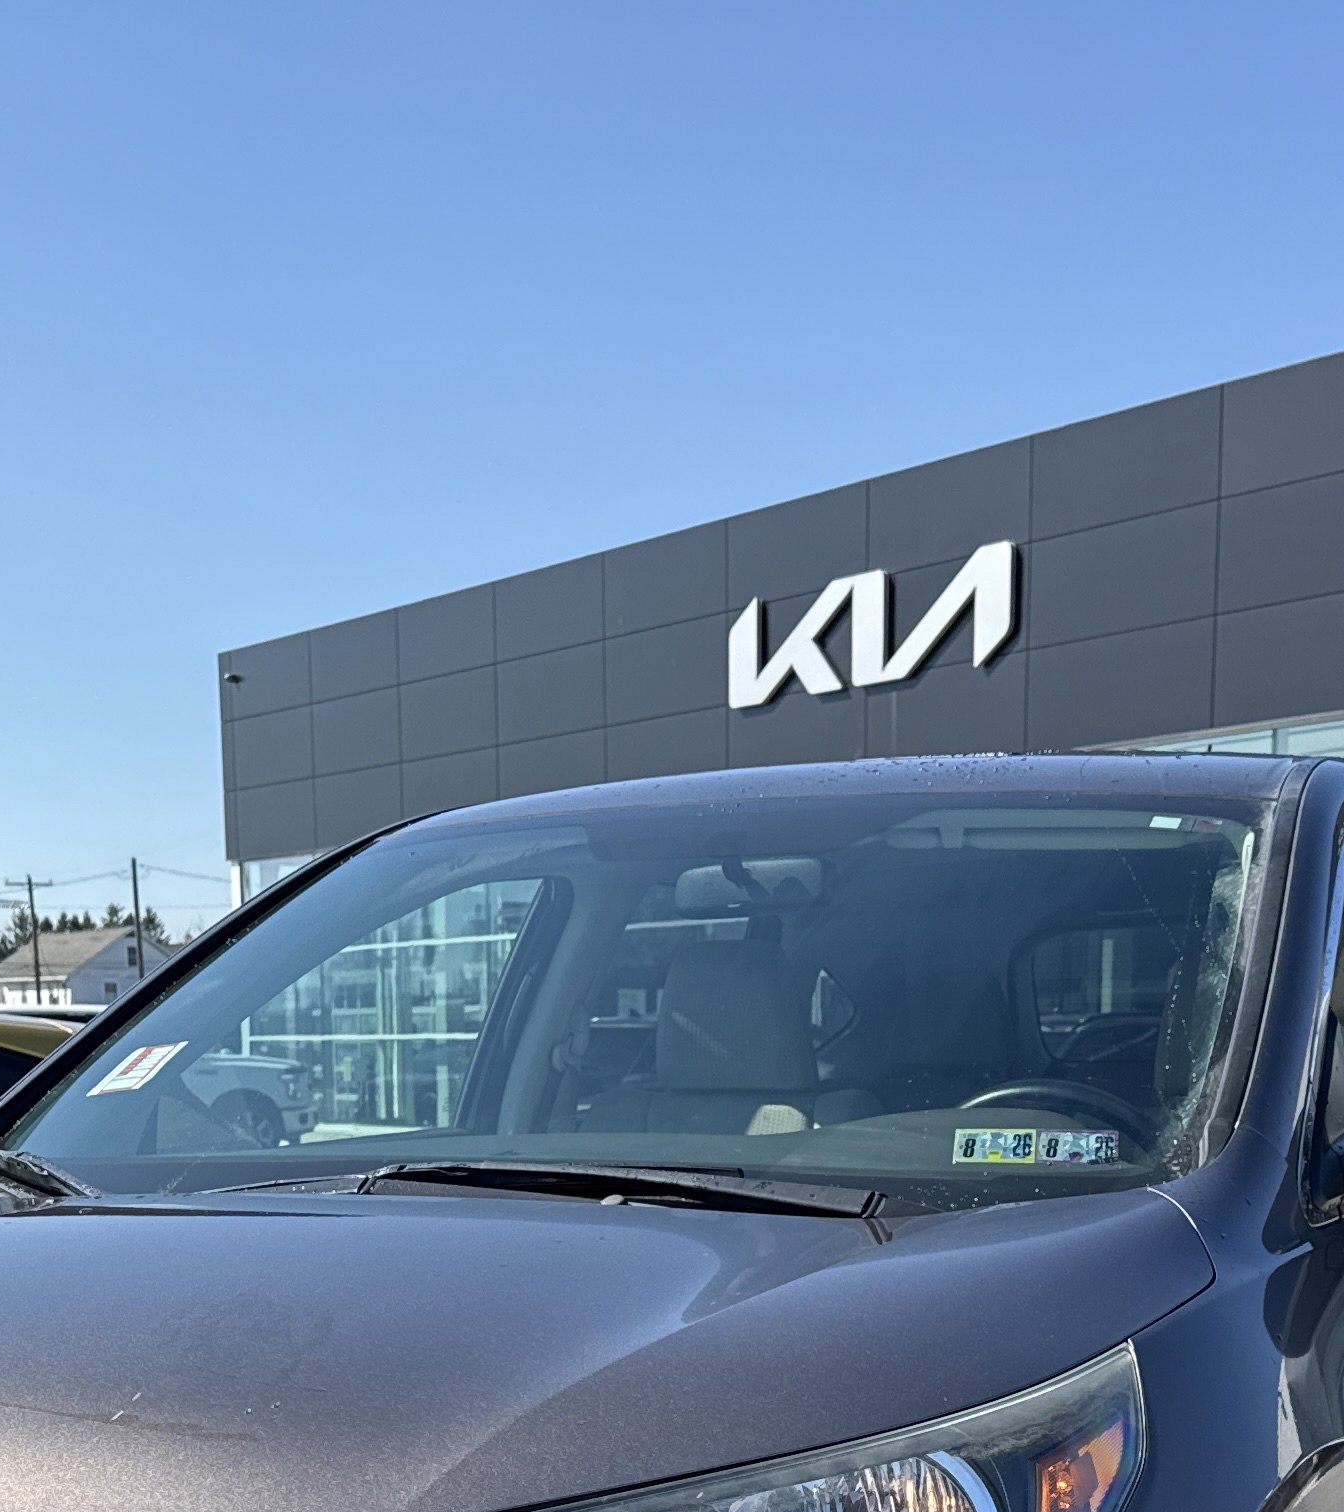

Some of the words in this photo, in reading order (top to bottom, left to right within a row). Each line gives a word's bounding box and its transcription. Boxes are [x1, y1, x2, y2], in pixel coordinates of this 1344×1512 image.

[728, 539, 1017, 710] KIA
[963, 1138, 976, 1158] 8
[1012, 1133, 1032, 1157] 26
[1045, 1138, 1059, 1158] 8
